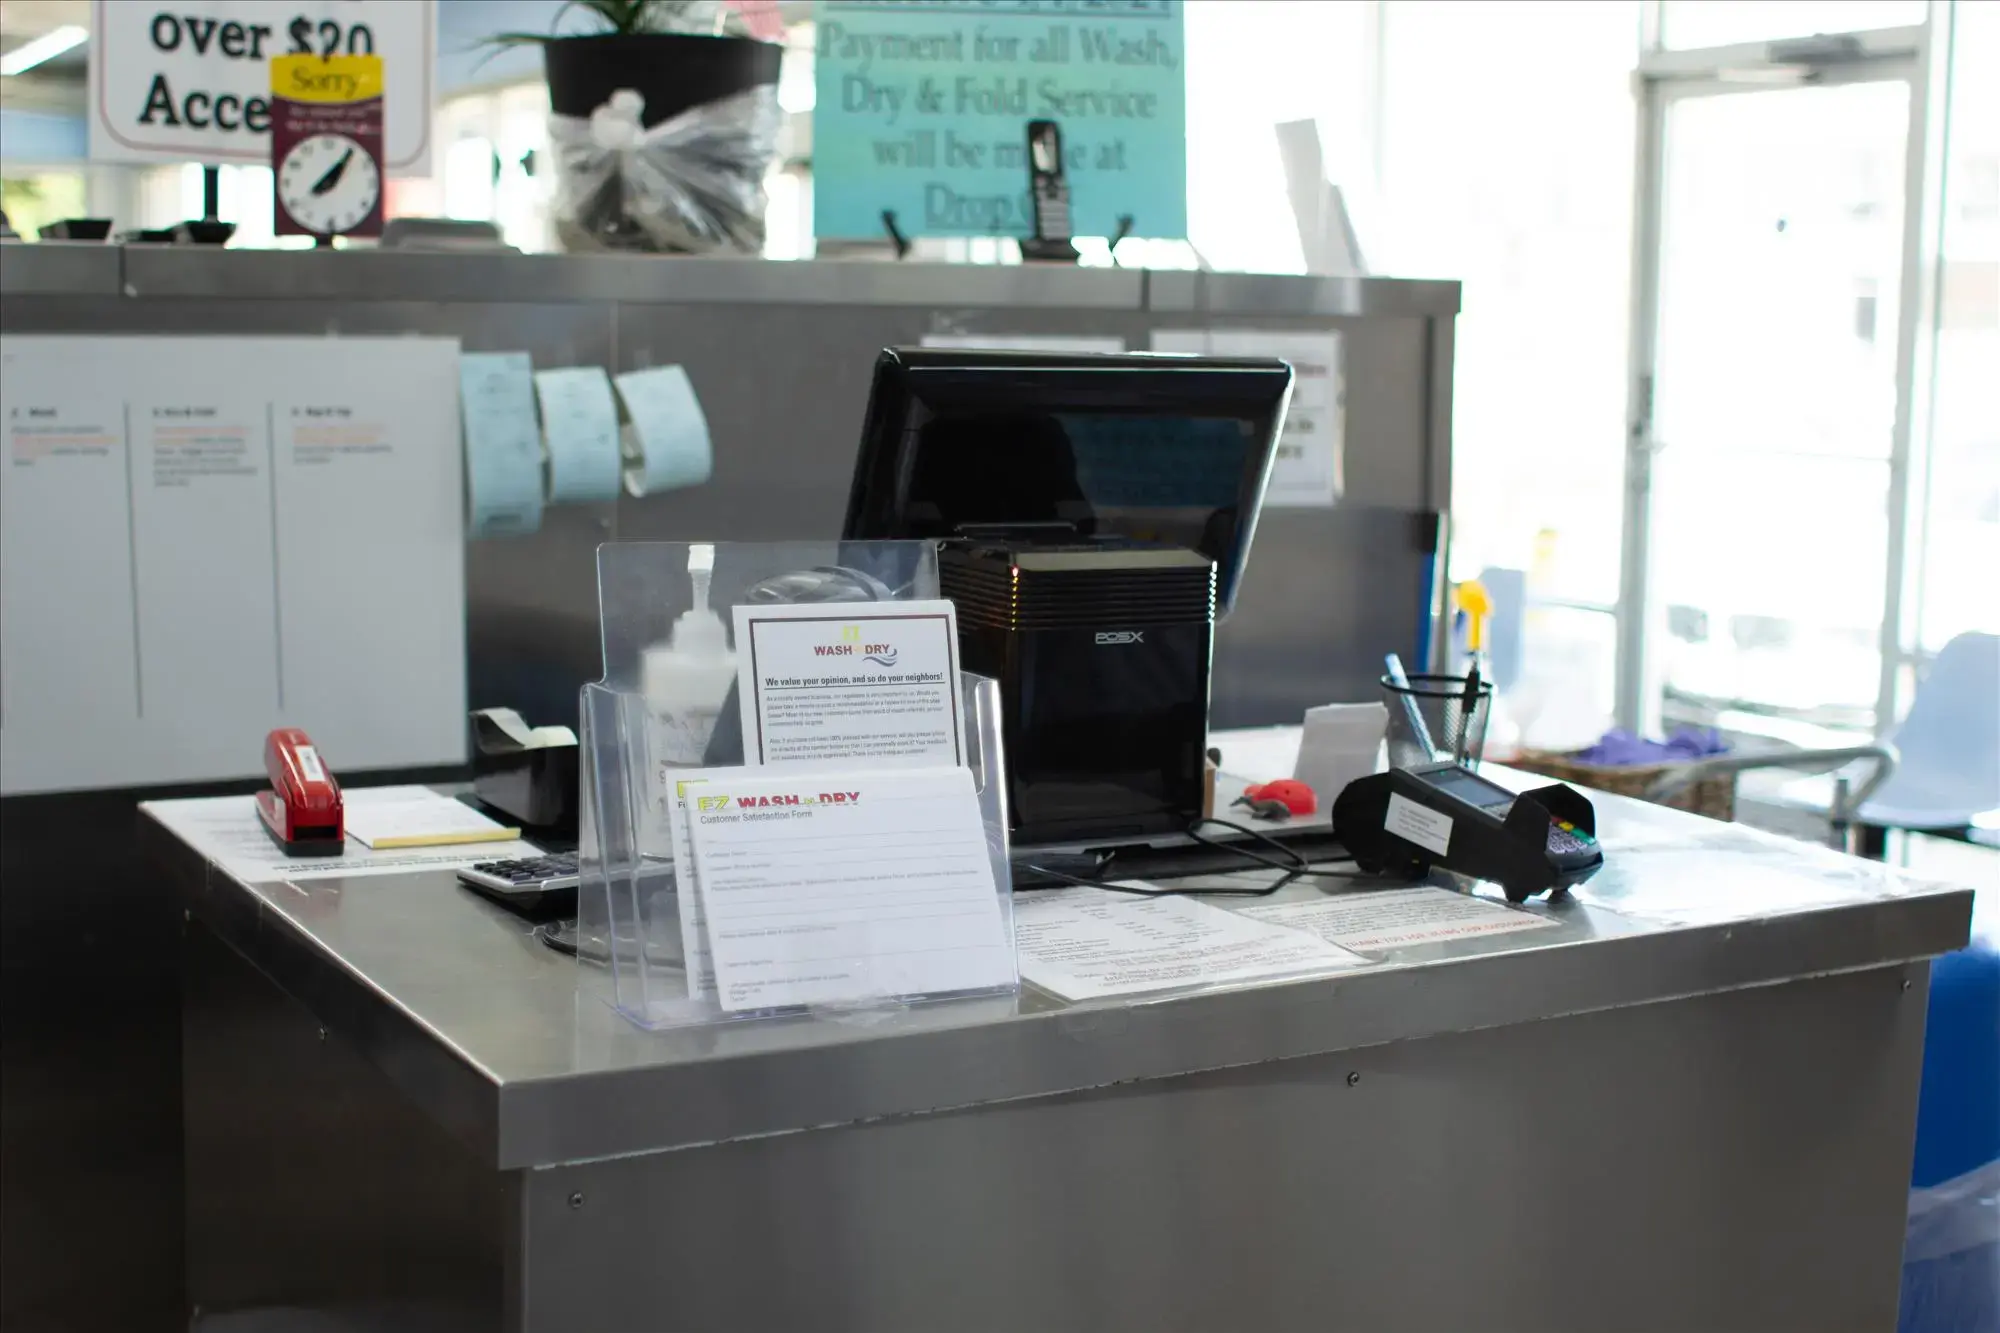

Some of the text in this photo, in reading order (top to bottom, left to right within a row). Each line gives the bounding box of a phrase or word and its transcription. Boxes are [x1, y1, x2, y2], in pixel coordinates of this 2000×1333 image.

[151, 12, 271, 60] over
[816, 21, 964, 72] Payment
[974, 25, 1022, 63] for
[1029, 25, 1071, 63] all
[291, 65, 357, 98] Sorry
[841, 74, 1158, 125] Dry & Fold Service
[873, 129, 1128, 170] will be me at
[924, 183, 1012, 234] Drop
[814, 644, 890, 656] WASH DRY
[766, 677, 779, 687] We
[781, 677, 801, 686] value
[803, 678, 819, 688] your
[821, 676, 851, 686] opinion,
[852, 674, 866, 684] and
[878, 674, 887, 682] do
[888, 675, 904, 685] your
[905, 672, 943, 683] neighbors!
[700, 814, 741, 825] Customer
[791, 809, 813, 819] Form
[736, 794, 800, 809] WASH
[819, 792, 860, 806] DRY
